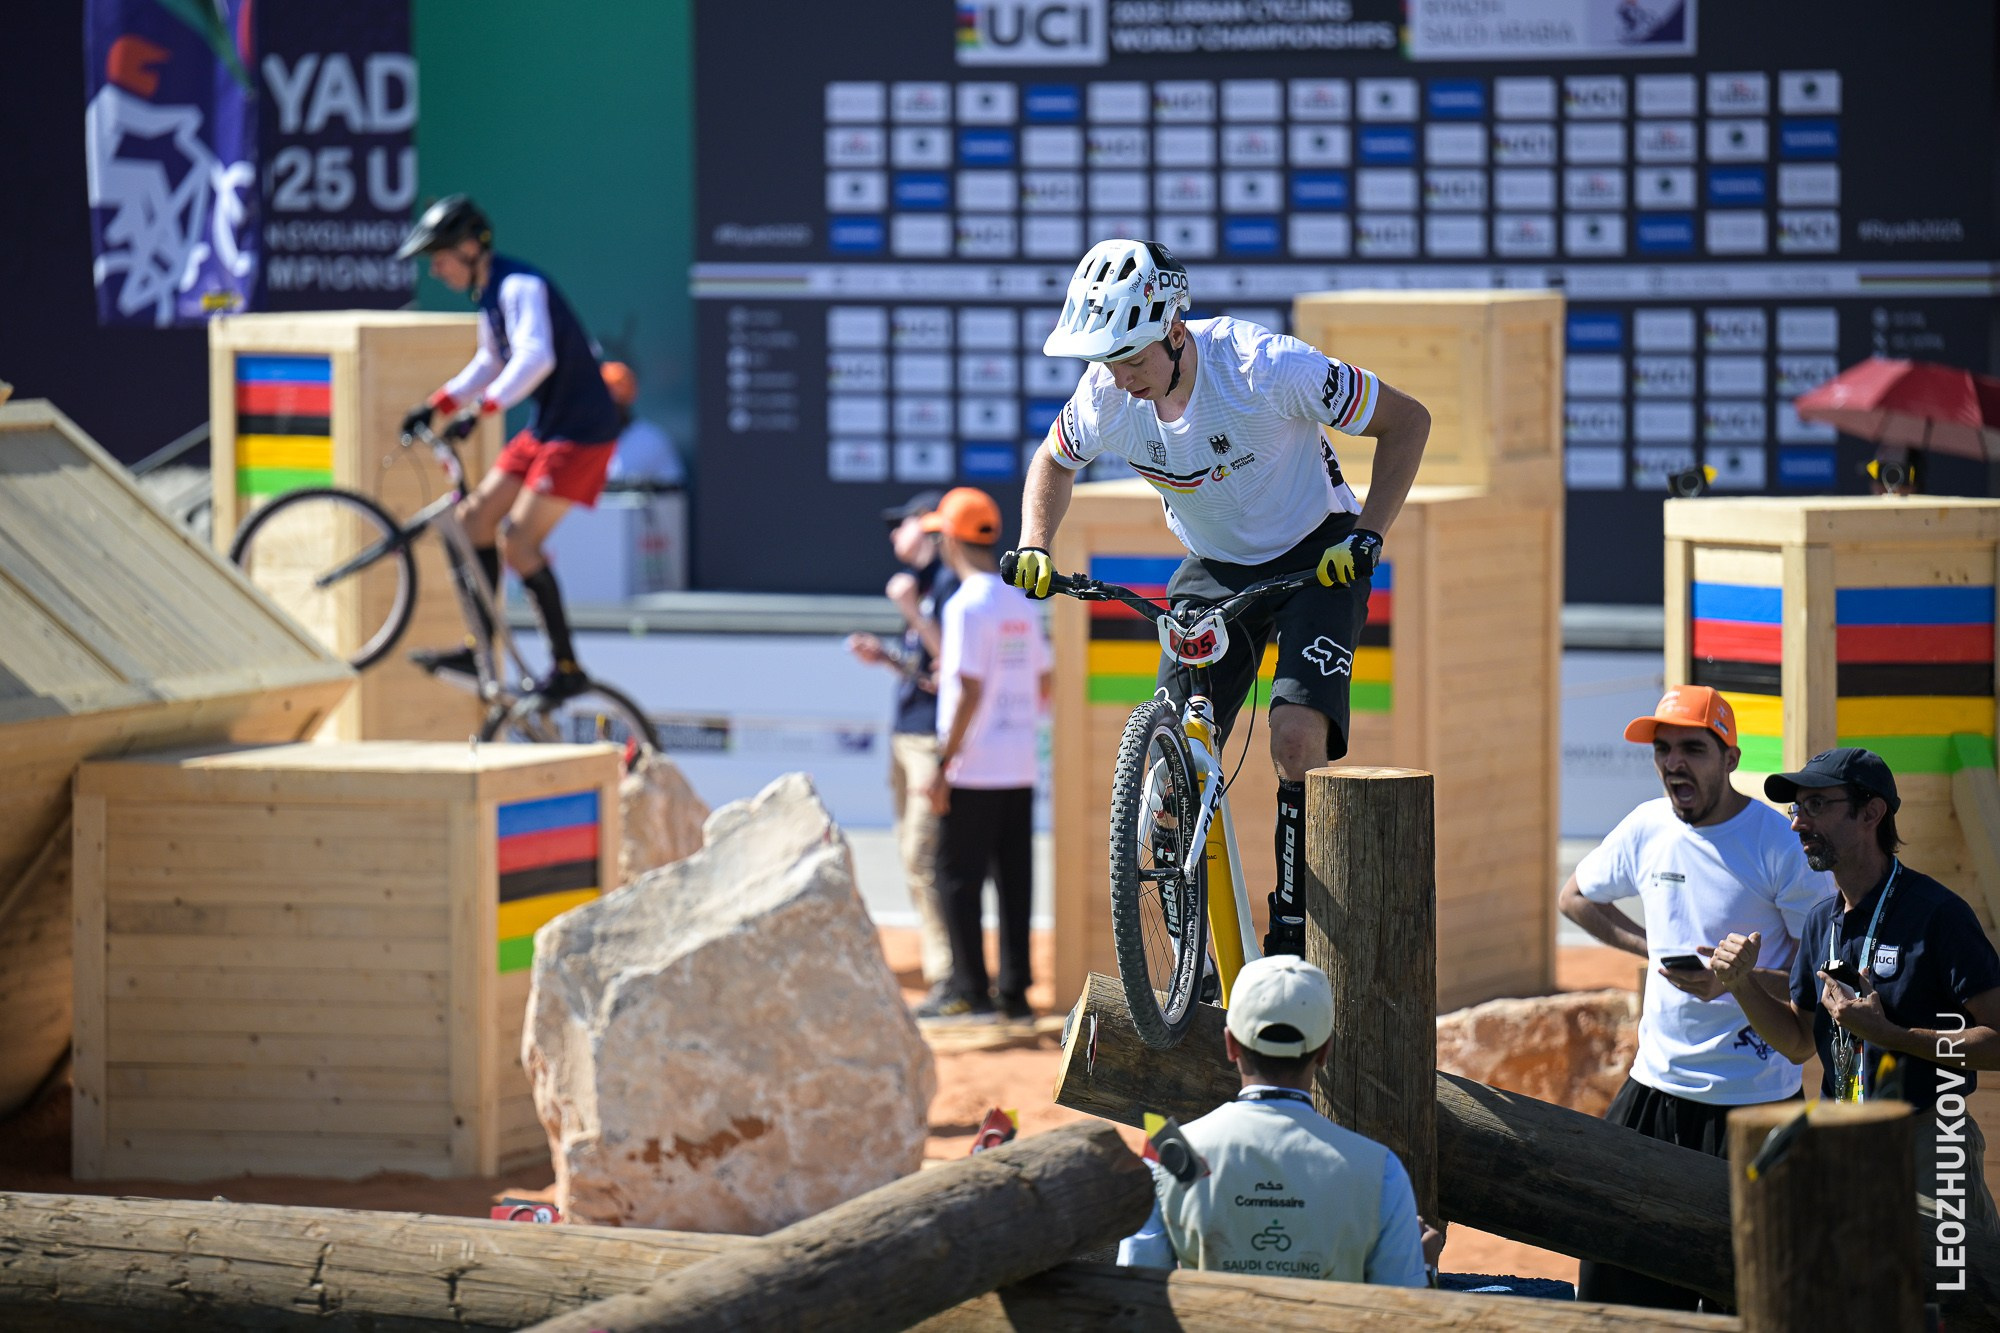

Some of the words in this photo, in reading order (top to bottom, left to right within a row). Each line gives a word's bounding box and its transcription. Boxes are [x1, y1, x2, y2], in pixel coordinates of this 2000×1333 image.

[987, 2, 1091, 47] UCI
[264, 147, 357, 212] 25
[1230, 453, 1254, 467] german
[1233, 457, 1255, 470] cycling
[1281, 824, 1295, 904] hebo
[1879, 956, 1895, 965] UCI
[1255, 1181, 1283, 1192] حكم
[1235, 1195, 1305, 1208] Commissaire
[1222, 1260, 1261, 1271] SAUDI
[1266, 1261, 1320, 1273] CYCLING
